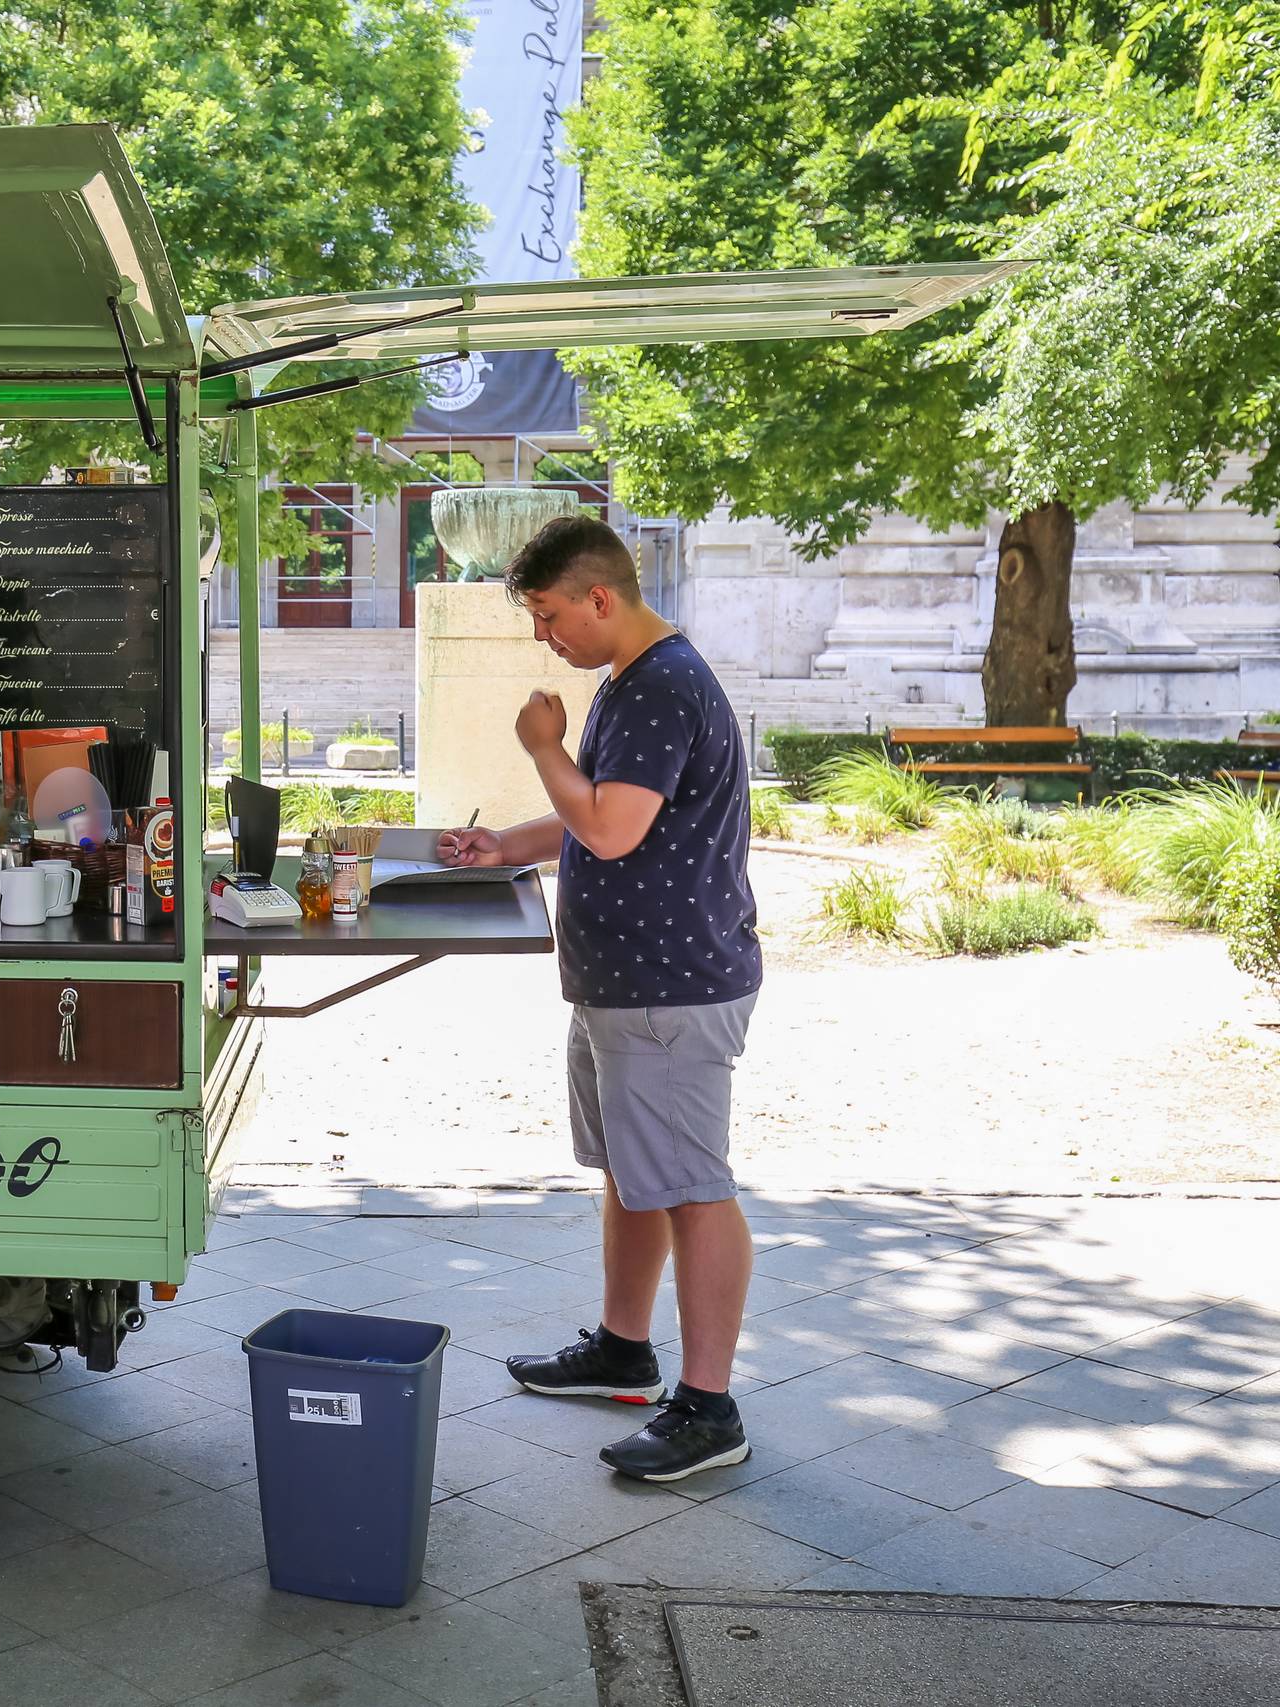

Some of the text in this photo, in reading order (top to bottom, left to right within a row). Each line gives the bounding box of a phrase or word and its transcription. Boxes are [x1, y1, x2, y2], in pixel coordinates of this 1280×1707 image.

[521, 80, 563, 264] Exchange
[36, 542, 93, 555] macchiato
[150, 608, 159, 620] €
[19, 707, 46, 722] latte
[152, 869, 174, 879] PREMI
[156, 879, 175, 888] BARIST
[307, 1406, 320, 1416] 25
